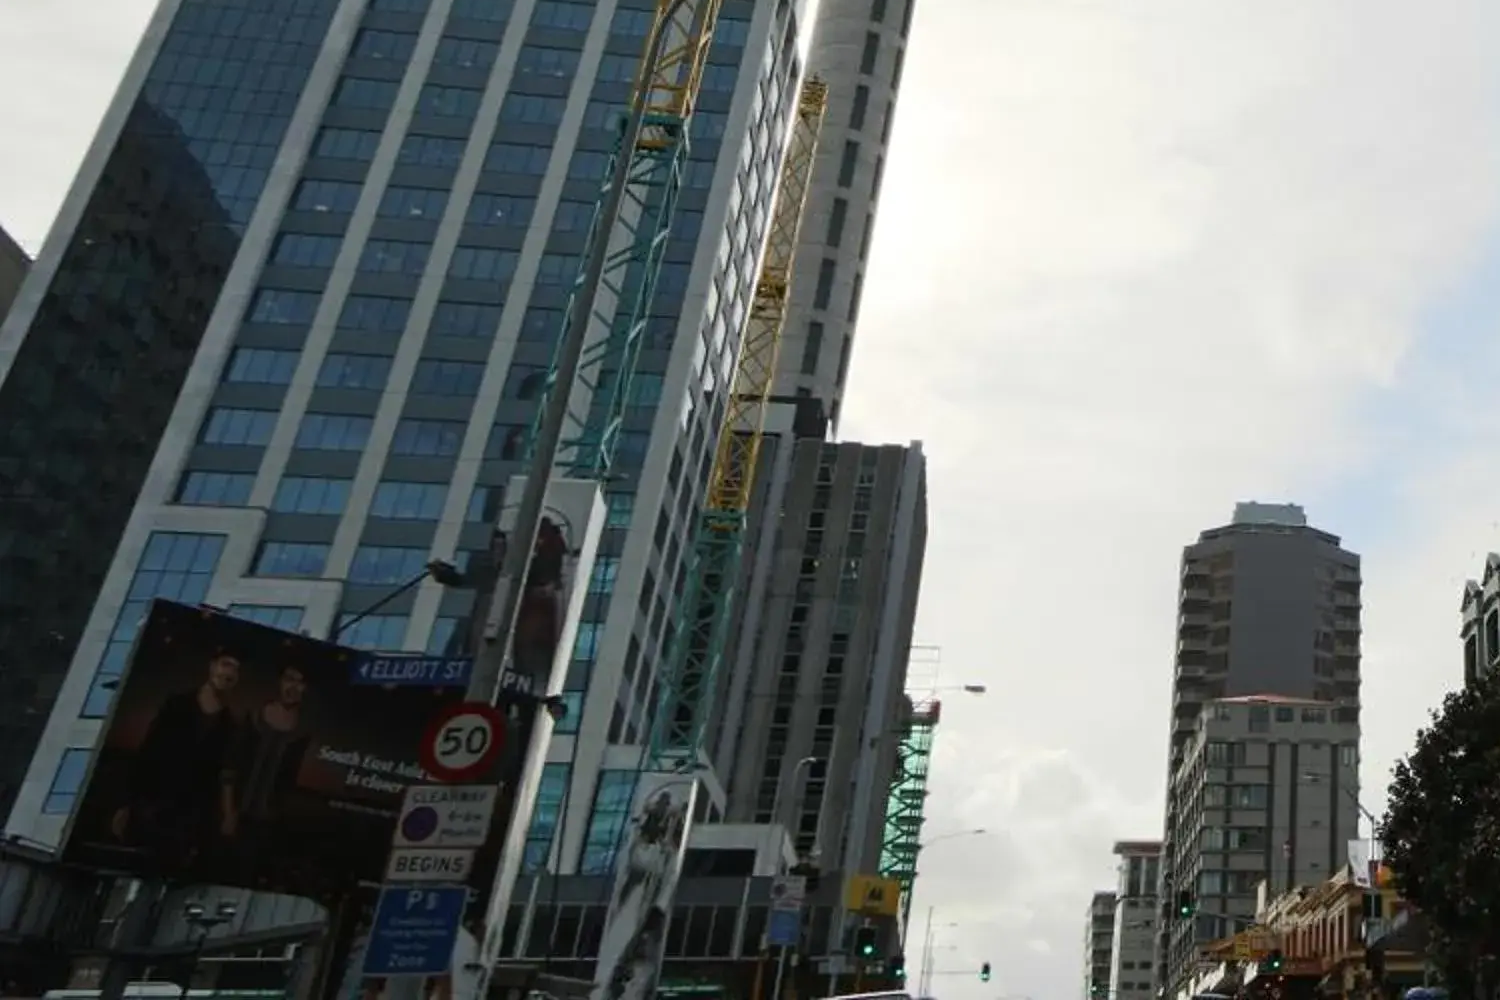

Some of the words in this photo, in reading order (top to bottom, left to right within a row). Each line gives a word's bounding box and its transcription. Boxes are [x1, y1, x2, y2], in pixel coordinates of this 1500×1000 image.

[370, 659, 441, 679] ELLIOTT
[443, 659, 469, 679] ST
[440, 726, 488, 757] 50
[316, 745, 361, 767] South
[412, 789, 488, 804] CLEARWAY
[394, 855, 465, 873] BEGINS
